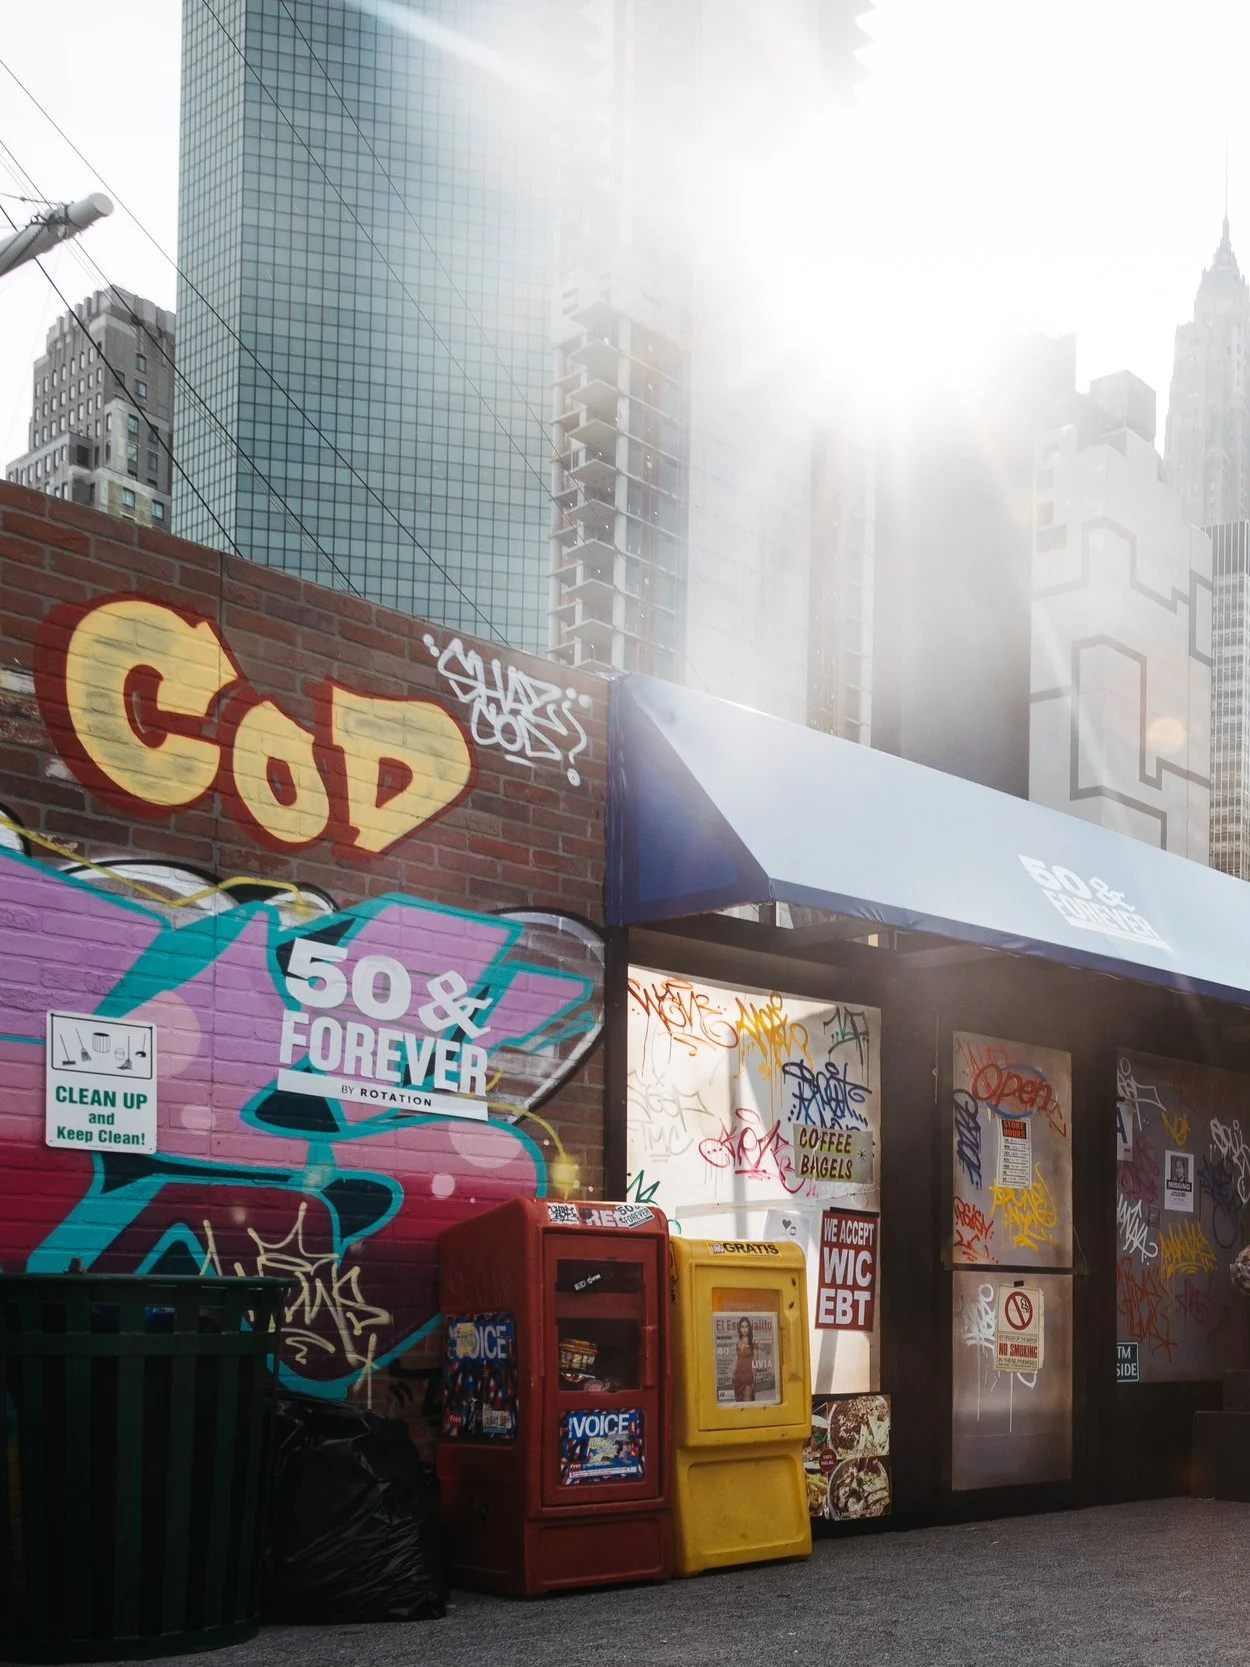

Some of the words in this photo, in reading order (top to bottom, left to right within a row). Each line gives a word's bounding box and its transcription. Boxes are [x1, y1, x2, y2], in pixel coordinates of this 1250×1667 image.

[1018, 854, 1093, 899] 50
[1089, 876, 1136, 914] &
[1042, 888, 1163, 941] FOREVER
[285, 938, 411, 1021] 50
[418, 970, 493, 1039] &
[279, 1010, 488, 1097] FOREVER
[55, 1085, 116, 1108] CLEAN
[123, 1092, 148, 1110] UP
[341, 1084, 355, 1095] BY
[360, 1087, 433, 1107] ROTATION
[88, 1112, 115, 1126] and
[1003, 1120, 1025, 1130] STORE
[57, 1125, 93, 1143] Keep
[99, 1129, 145, 1146] Clean!
[799, 1127, 853, 1154] COFFEE
[1003, 1128, 1025, 1138] HOURS
[801, 1154, 853, 1180] BAGELS
[1168, 1181, 1191, 1190] MISSING
[624, 1208, 652, 1225] FOREVER
[823, 1217, 839, 1243] WE
[841, 1218, 875, 1245] ACCEPT
[722, 1243, 780, 1255] GRATIS
[823, 1247, 873, 1288] WIC
[818, 1288, 872, 1327] EBT
[716, 1319, 725, 1331] El
[726, 1318, 772, 1332] Esialito
[999, 1342, 1008, 1356] NO
[1010, 1343, 1038, 1359] SMOKING
[1116, 1345, 1131, 1359] TM
[1116, 1363, 1137, 1377] SIDE
[572, 1413, 630, 1438] VOICE
